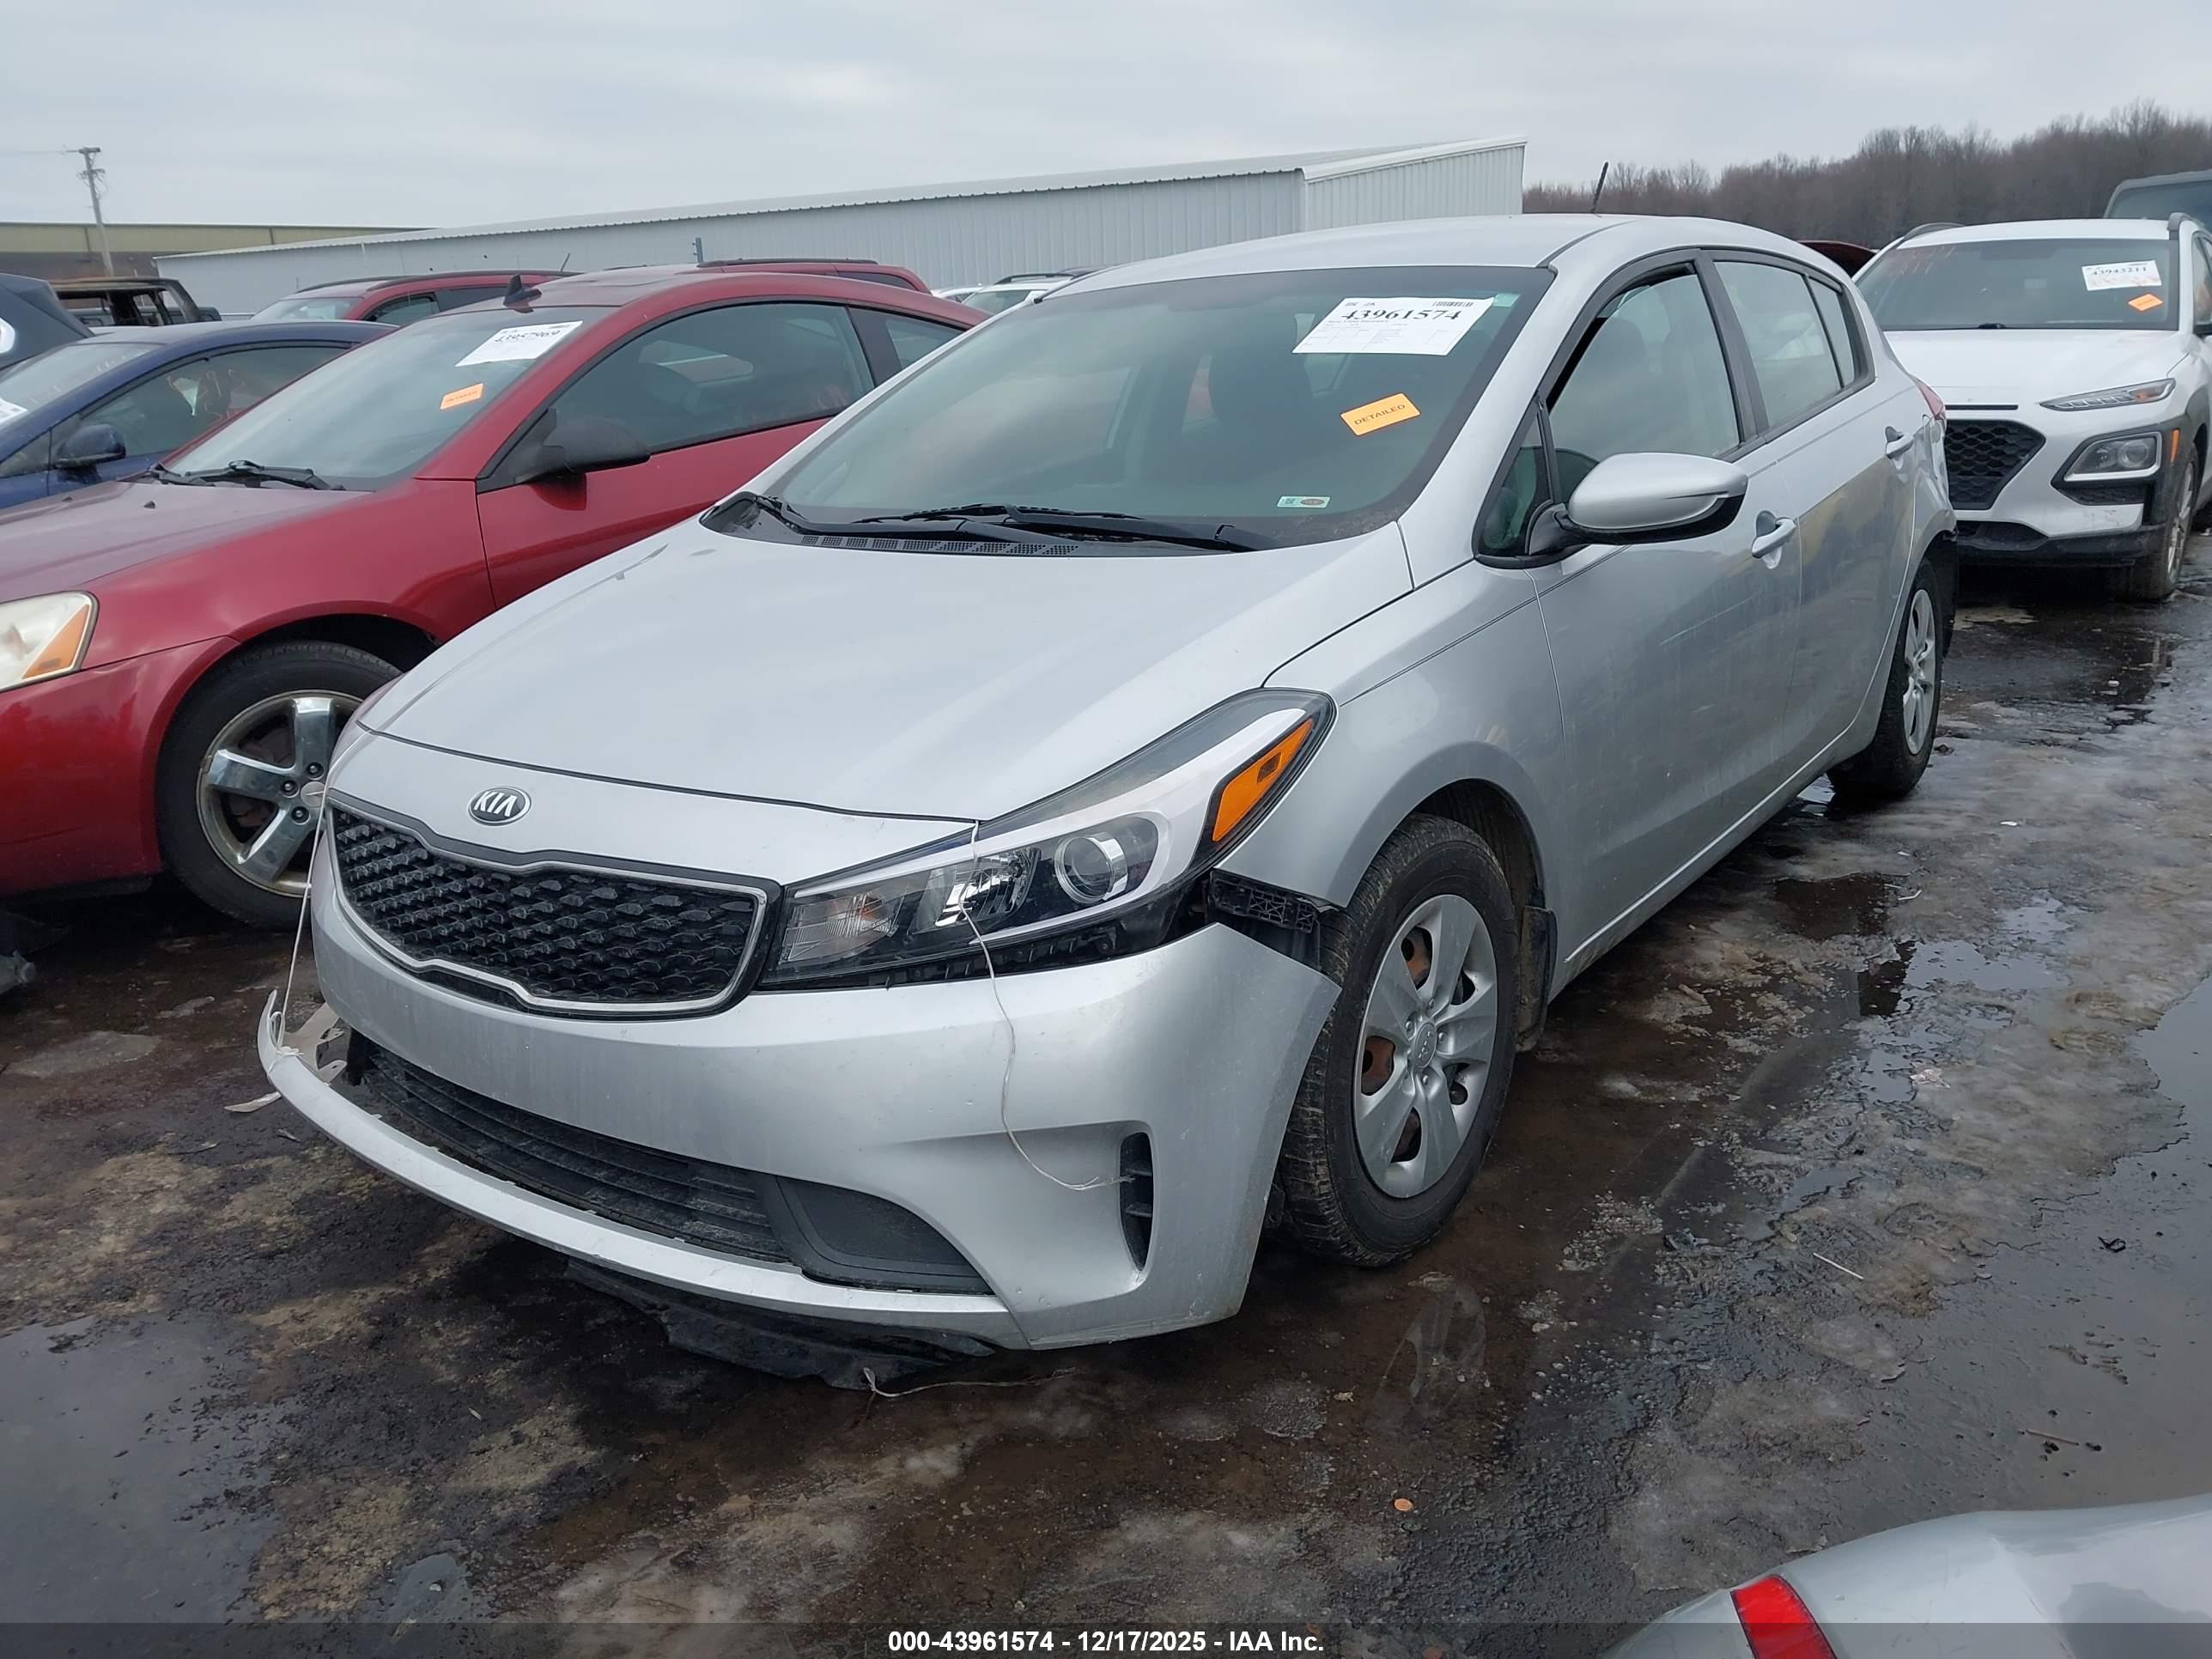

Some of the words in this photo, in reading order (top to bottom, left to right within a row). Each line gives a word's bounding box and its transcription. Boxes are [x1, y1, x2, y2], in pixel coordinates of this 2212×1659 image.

[1341, 309, 1462, 320] 43961574
[1354, 404, 1407, 425] DETAILED
[473, 790, 518, 817] KIA
